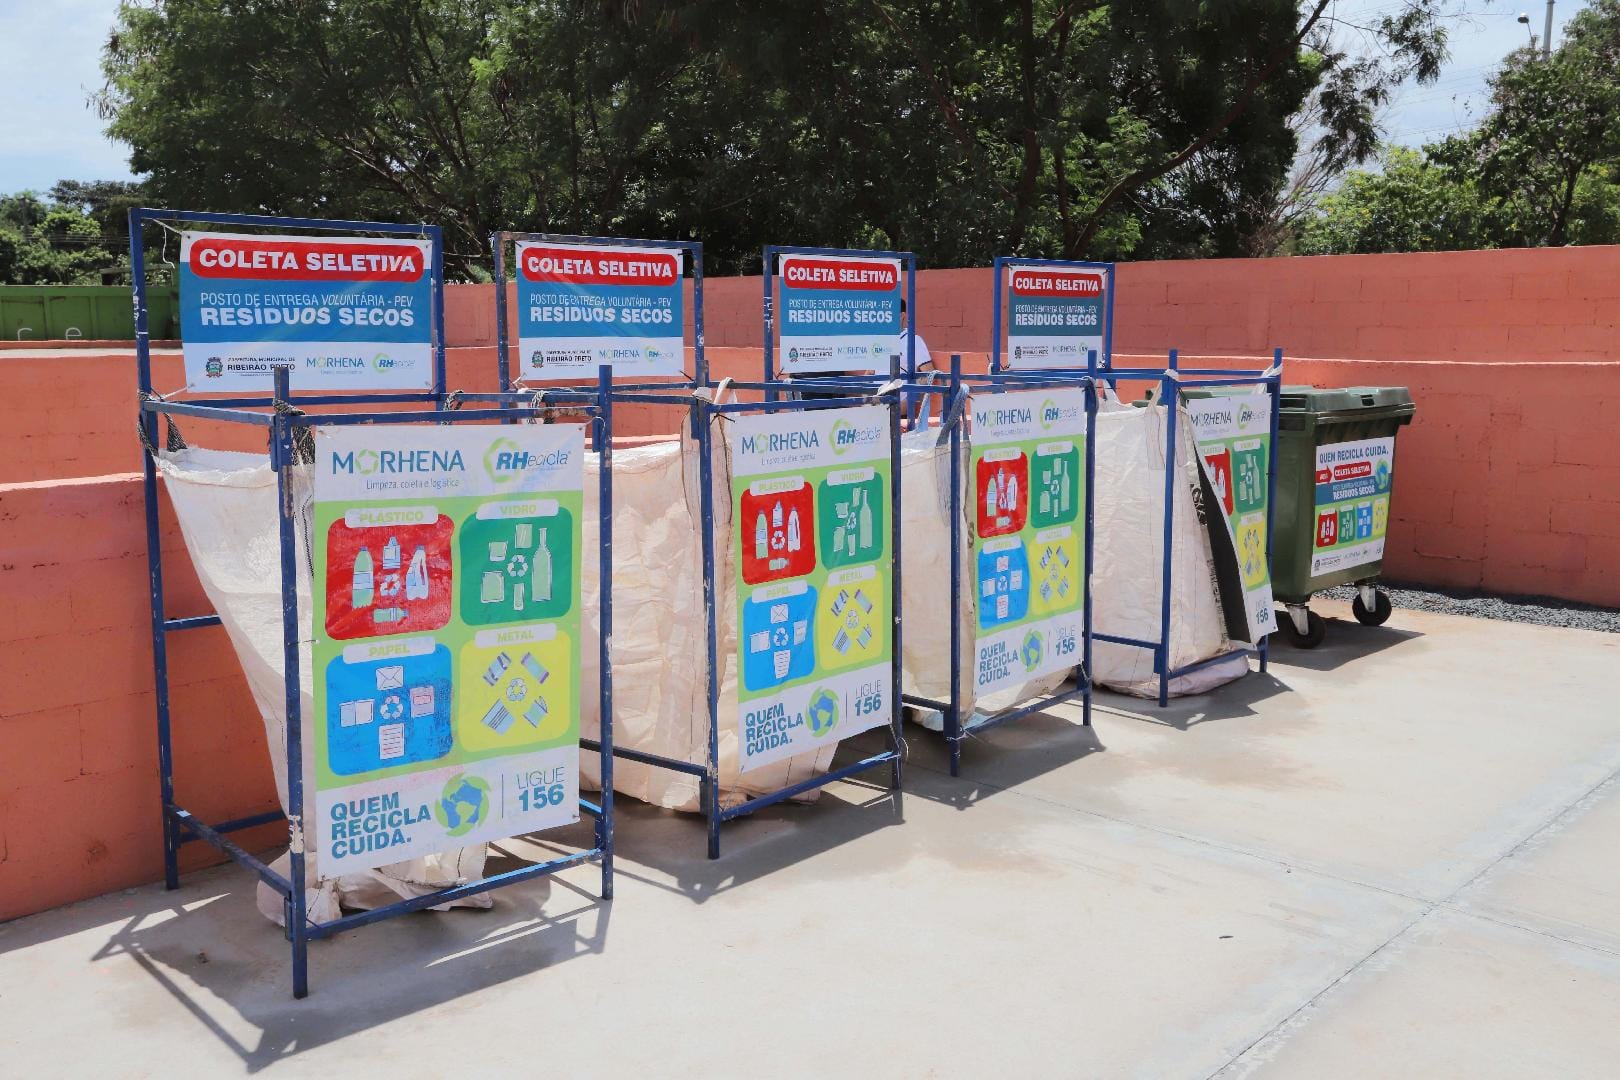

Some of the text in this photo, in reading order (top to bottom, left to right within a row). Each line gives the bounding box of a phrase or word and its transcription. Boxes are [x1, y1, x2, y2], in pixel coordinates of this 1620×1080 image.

[199, 248, 416, 273] COLETA SELETIVA
[527, 256, 673, 278] COLETA SELETIVA
[787, 266, 894, 284] COLETA SELETIVA
[1015, 277, 1099, 291] COLETA SELETIVA
[201, 293, 241, 305] POSTO
[245, 294, 260, 305] DE
[265, 294, 319, 306] ENTREGA
[322, 292, 385, 306] VOLUNTÁRIA
[394, 295, 413, 307] PEV
[530, 294, 557, 305] POSTO
[559, 295, 570, 305] DE
[570, 295, 606, 306] ENTREGA
[659, 297, 672, 307] PEV
[200, 305, 415, 327] RESÍDUOS SECOS
[621, 308, 673, 324] SECOS
[854, 310, 893, 323] SECOS
[1015, 312, 1097, 326] RESÍDUOS SECOS
[228, 363, 267, 371] RIBEIRÃO
[306, 357, 365, 368] MORHENA
[976, 408, 1032, 428] MORHENA
[742, 430, 820, 454] MORHENA
[332, 448, 465, 475] MORHENA
[1319, 444, 1389, 464] QUEM RECICLA CUIDA.
[500, 504, 537, 515] VIDRO
[1256, 608, 1268, 624] 156
[497, 629, 535, 642] METAL
[368, 644, 411, 657] PAPEL
[980, 641, 1006, 660] QUEM
[1055, 637, 1076, 656] 156
[979, 649, 1019, 673] RECICLA
[978, 667, 1011, 686] CUIDA.
[855, 679, 882, 699] LIGUE
[745, 702, 785, 727] QUEM
[854, 694, 882, 717] 156
[746, 712, 804, 743] RECICLA
[746, 732, 793, 757] CUIDA.
[516, 766, 566, 790] LIGUE
[330, 791, 400, 823] QUEM
[518, 783, 564, 812] 156
[331, 804, 431, 841] RECICLA
[331, 828, 412, 860] CUIDA.
